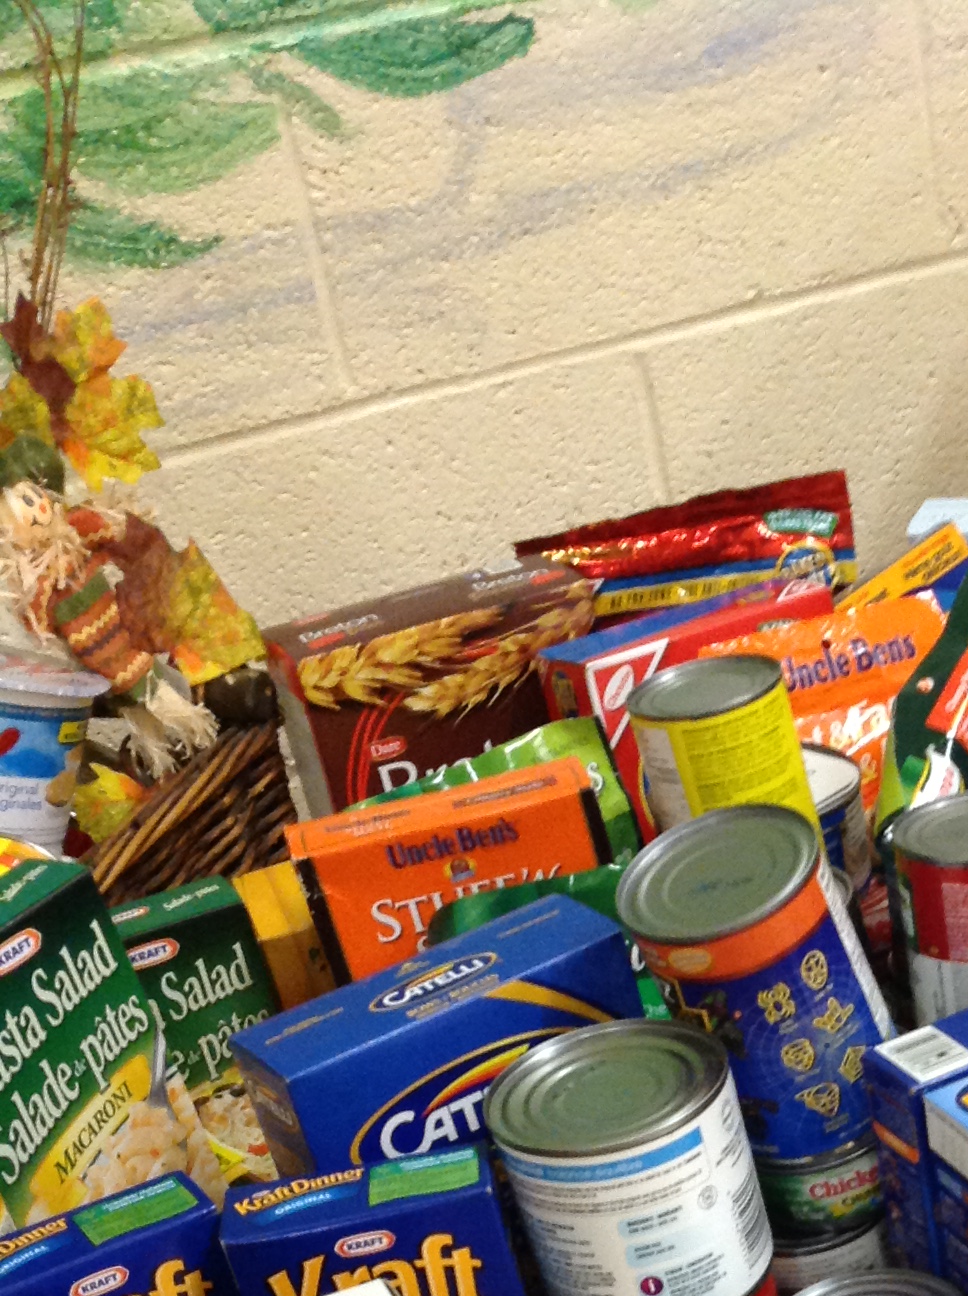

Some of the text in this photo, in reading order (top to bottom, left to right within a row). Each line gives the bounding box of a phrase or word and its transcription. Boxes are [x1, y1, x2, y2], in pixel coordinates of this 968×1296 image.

[385, 834, 456, 870] Uncle
[31, 918, 118, 1027] Salad
[161, 941, 253, 1021] Salad
[382, 959, 484, 1006] CATELLI
[0, 1059, 80, 1186] Salade
[80, 995, 149, 1095] pâtes
[53, 1081, 133, 1184] MACARONI
[345, 1236, 385, 1253] KRAFT
[81, 1273, 120, 1293] KRAFT
